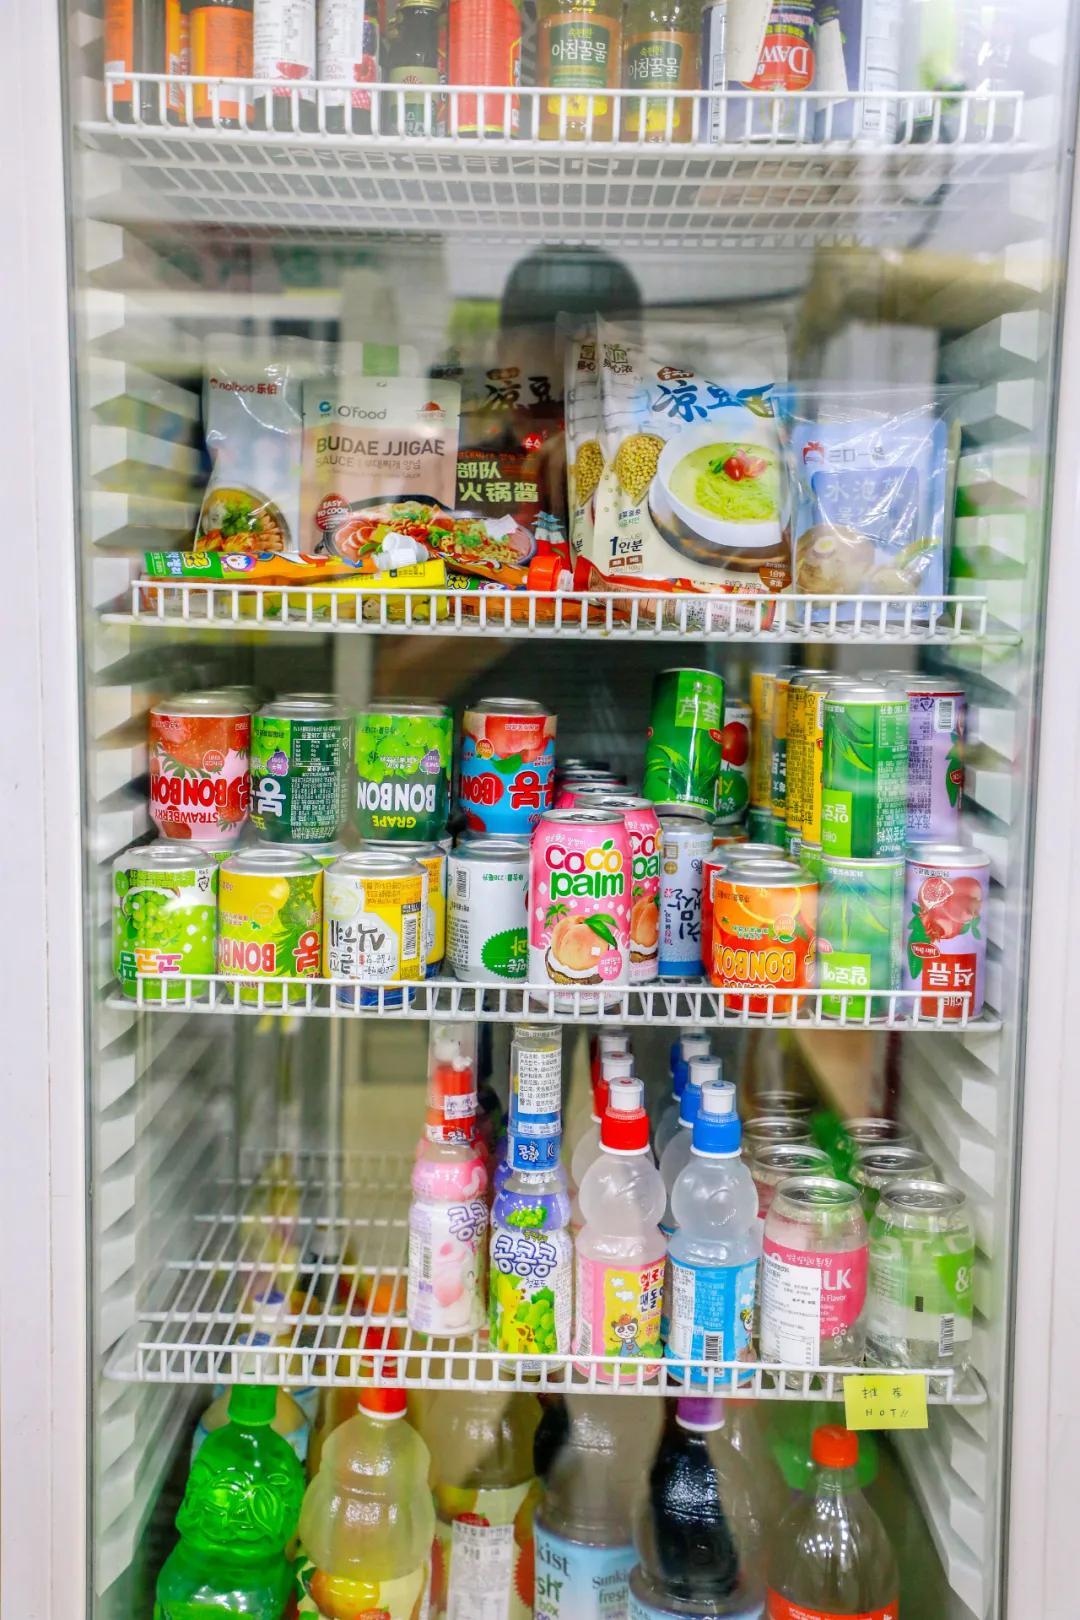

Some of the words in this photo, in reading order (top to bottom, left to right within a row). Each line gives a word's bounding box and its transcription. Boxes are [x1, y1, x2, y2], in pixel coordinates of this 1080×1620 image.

[551, 39, 608, 64] 아침꿀물
[629, 57, 680, 80] 아침꿀물
[316, 435, 379, 456] BUDAE
[381, 438, 446, 457] JJIGAE
[315, 454, 355, 468] SAUCE
[456, 461, 502, 479] 部队
[458, 481, 539, 503] 火锅酱
[609, 536, 644, 557] 1인분
[678, 697, 720, 725] 芦荟
[155, 808, 219, 823] STRAWBERRY
[371, 814, 417, 829] GRAPE
[548, 871, 625, 901] palm
[330, 919, 386, 953] 식혜
[927, 961, 975, 987] 석류
[493, 1234, 558, 1278] 콩콩콩
